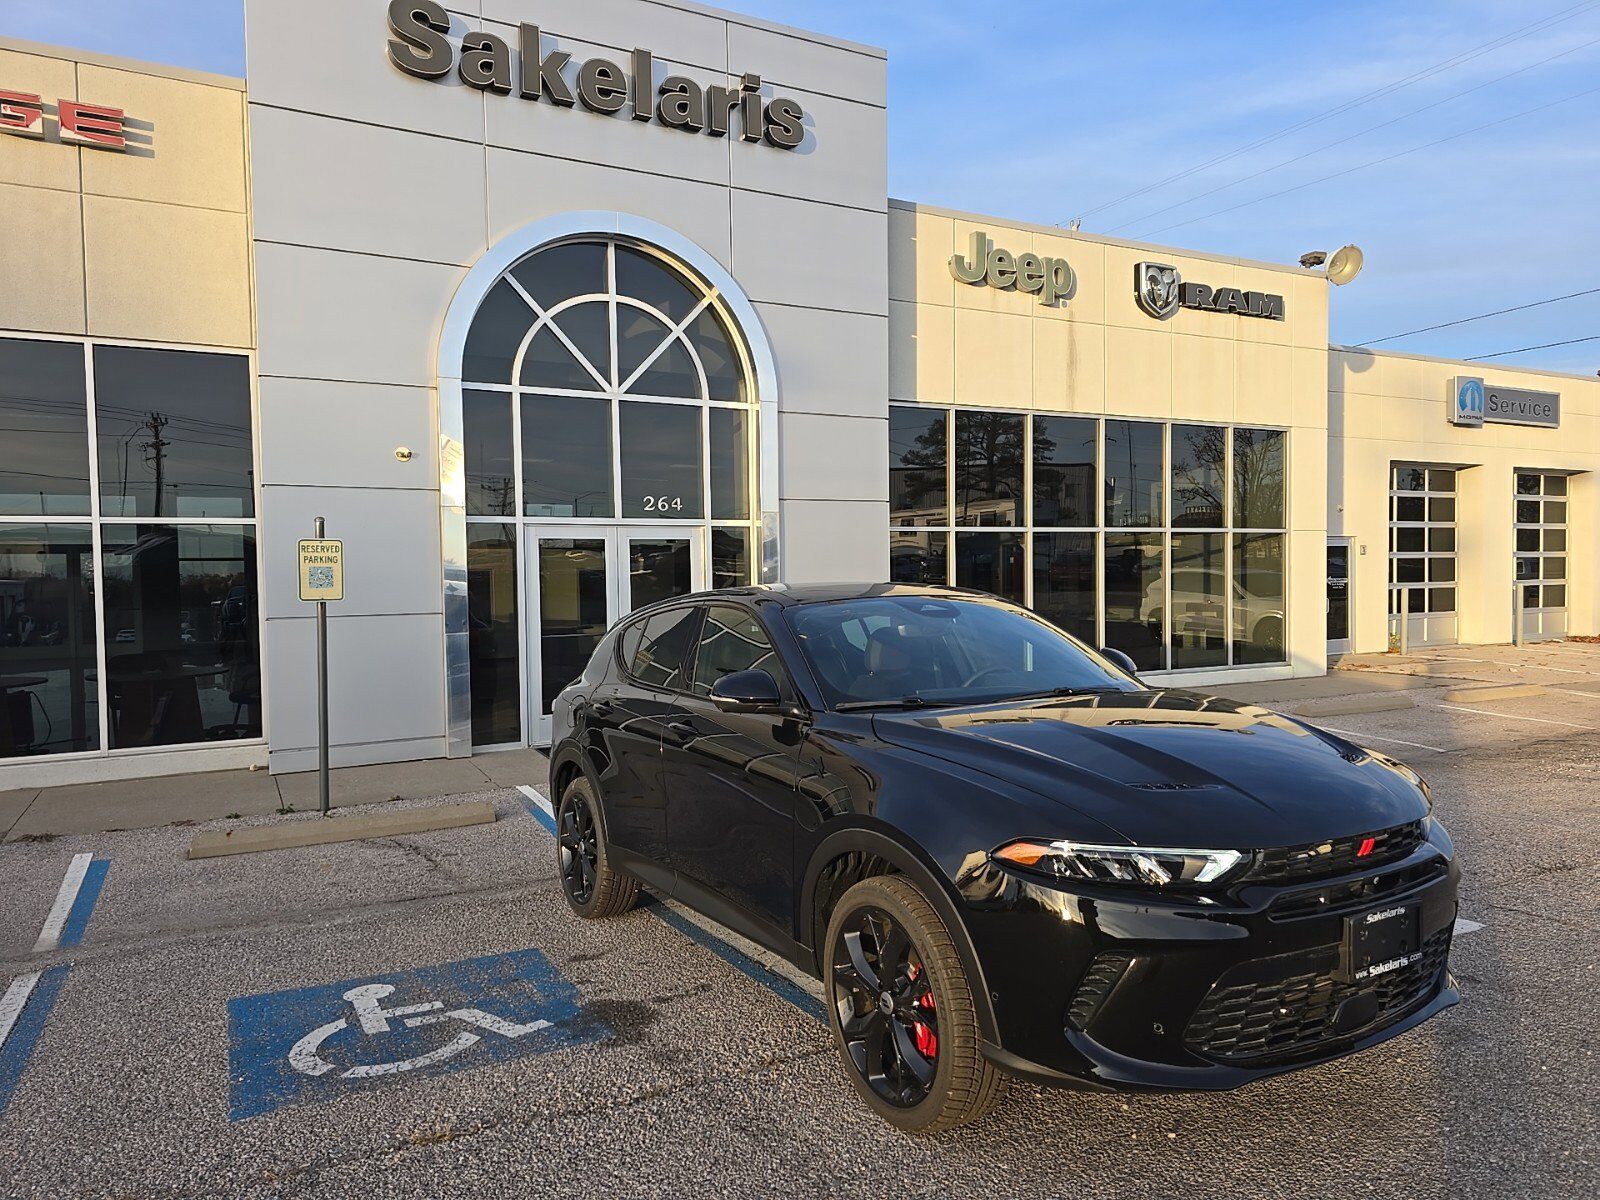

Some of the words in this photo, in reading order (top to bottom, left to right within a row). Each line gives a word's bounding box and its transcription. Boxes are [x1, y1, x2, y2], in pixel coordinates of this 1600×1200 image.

[386, 0, 806, 149] Sakelaris
[949, 231, 1073, 305] Jeep
[1179, 282, 1285, 321] RAM
[1489, 394, 1551, 417] Service
[642, 495, 683, 512] 264
[301, 544, 340, 553] RESERVED
[303, 555, 338, 564] PARKING
[1366, 906, 1405, 924] Sakelaris
